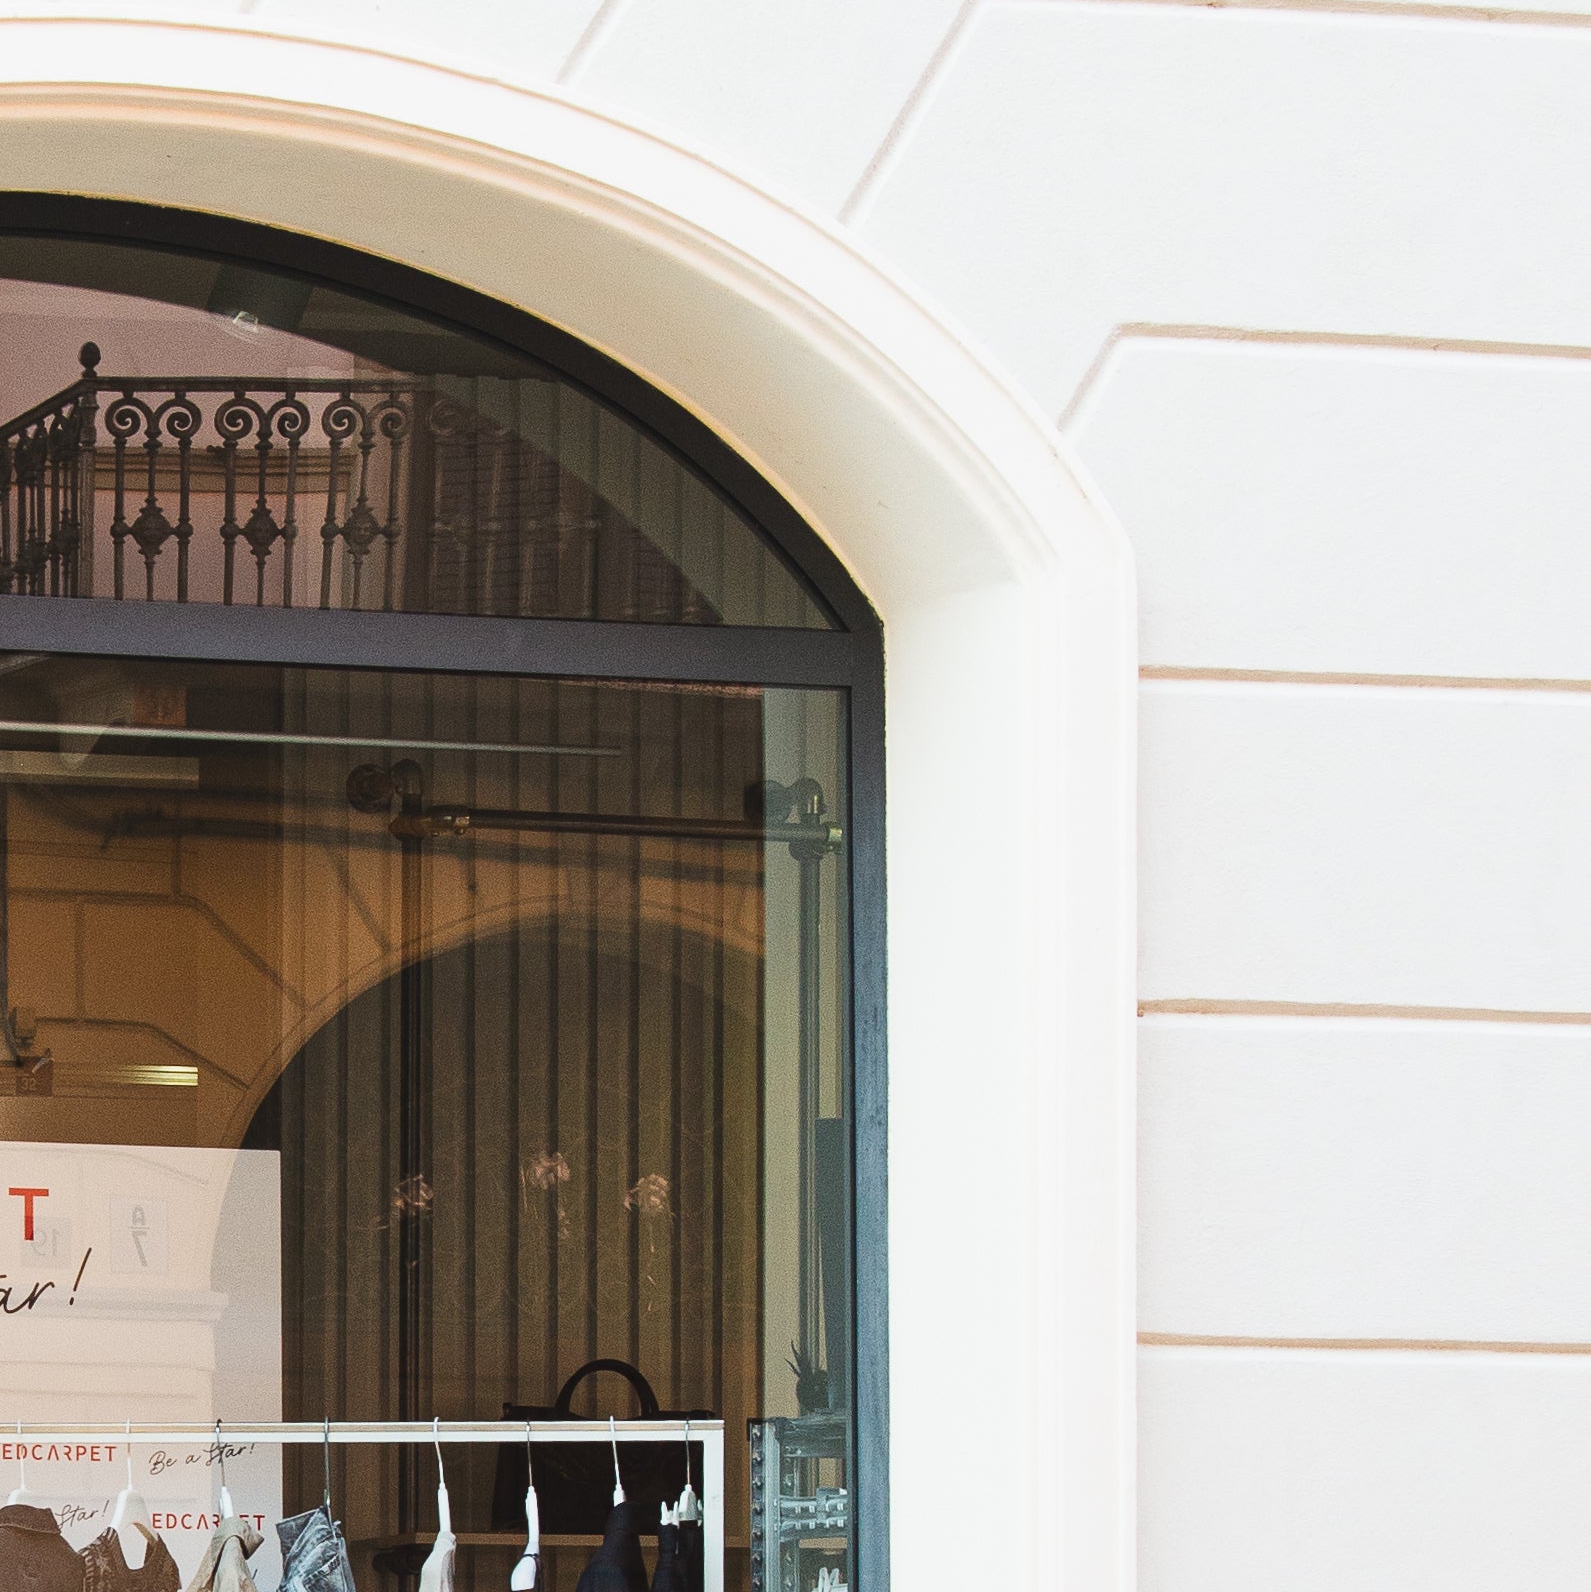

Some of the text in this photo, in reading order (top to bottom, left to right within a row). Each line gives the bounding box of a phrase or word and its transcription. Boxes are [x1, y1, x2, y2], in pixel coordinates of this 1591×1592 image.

[149, 1442, 256, 1475] Be a Star!
[54, 1499, 109, 1529] Star!
[152, 1513, 266, 1531] EDCART
